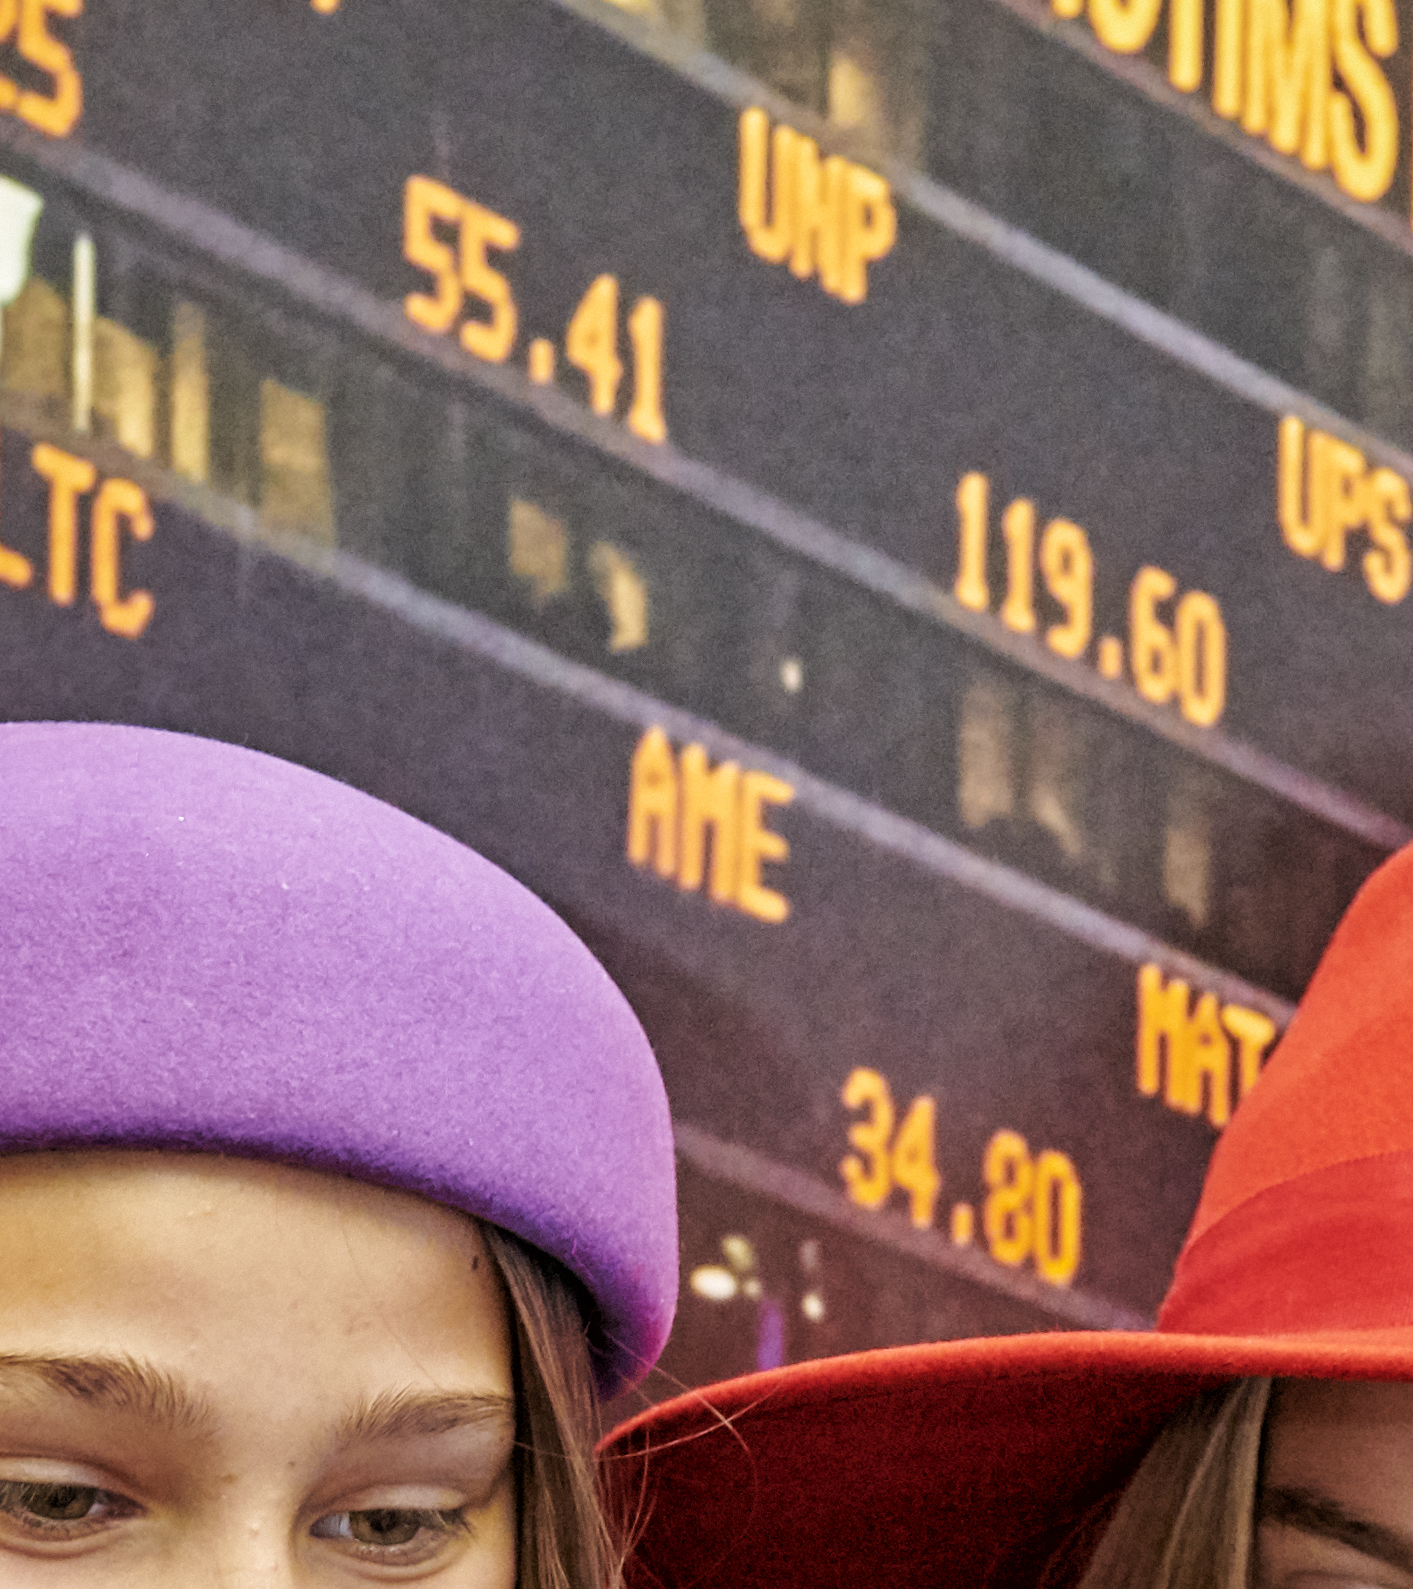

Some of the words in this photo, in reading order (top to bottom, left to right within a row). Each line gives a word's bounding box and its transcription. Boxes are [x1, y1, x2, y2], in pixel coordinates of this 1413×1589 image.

[402, 173, 668, 446] 55.41
[737, 103, 898, 304] UNP
[953, 470, 1228, 729] 119.60
[627, 726, 794, 925] AME
[840, 1065, 1084, 1289] 34.80
